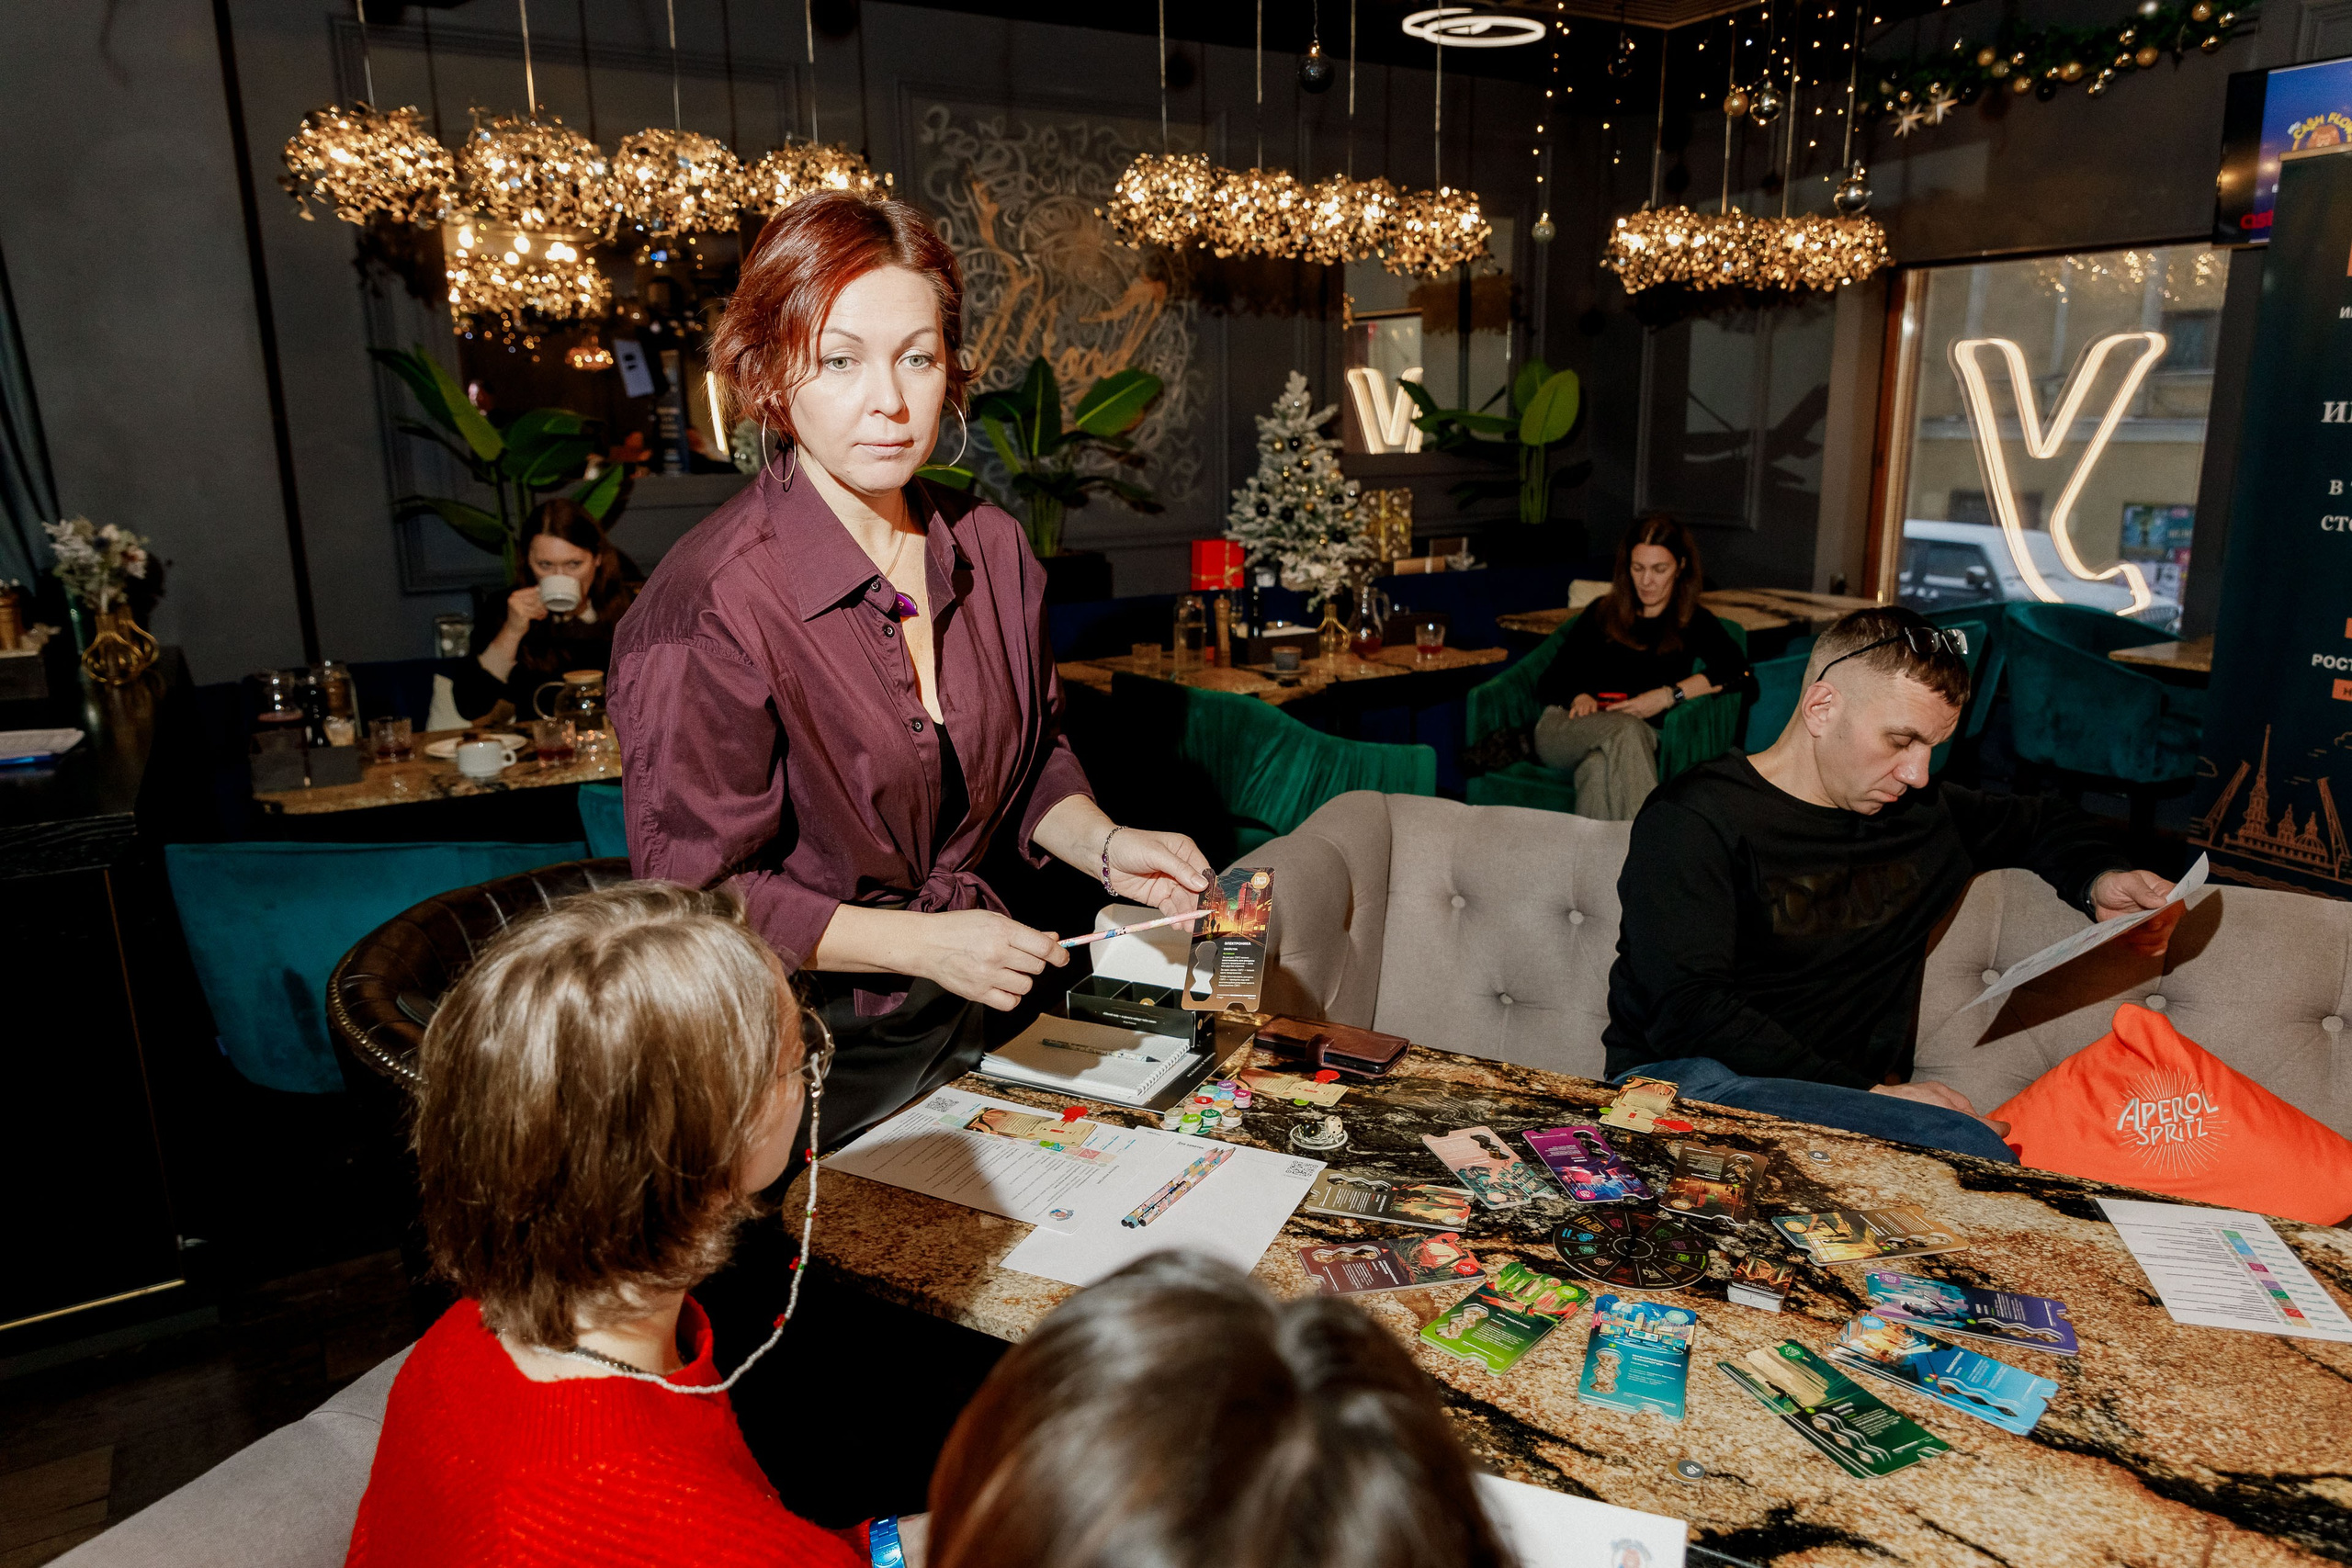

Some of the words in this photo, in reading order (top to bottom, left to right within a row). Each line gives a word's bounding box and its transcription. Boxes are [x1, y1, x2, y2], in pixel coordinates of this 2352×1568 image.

[2321, 400, 2352, 423] И
[2116, 1089, 2219, 1131] APEROL
[1742, 1280, 1776, 1292] RYBAKOV
